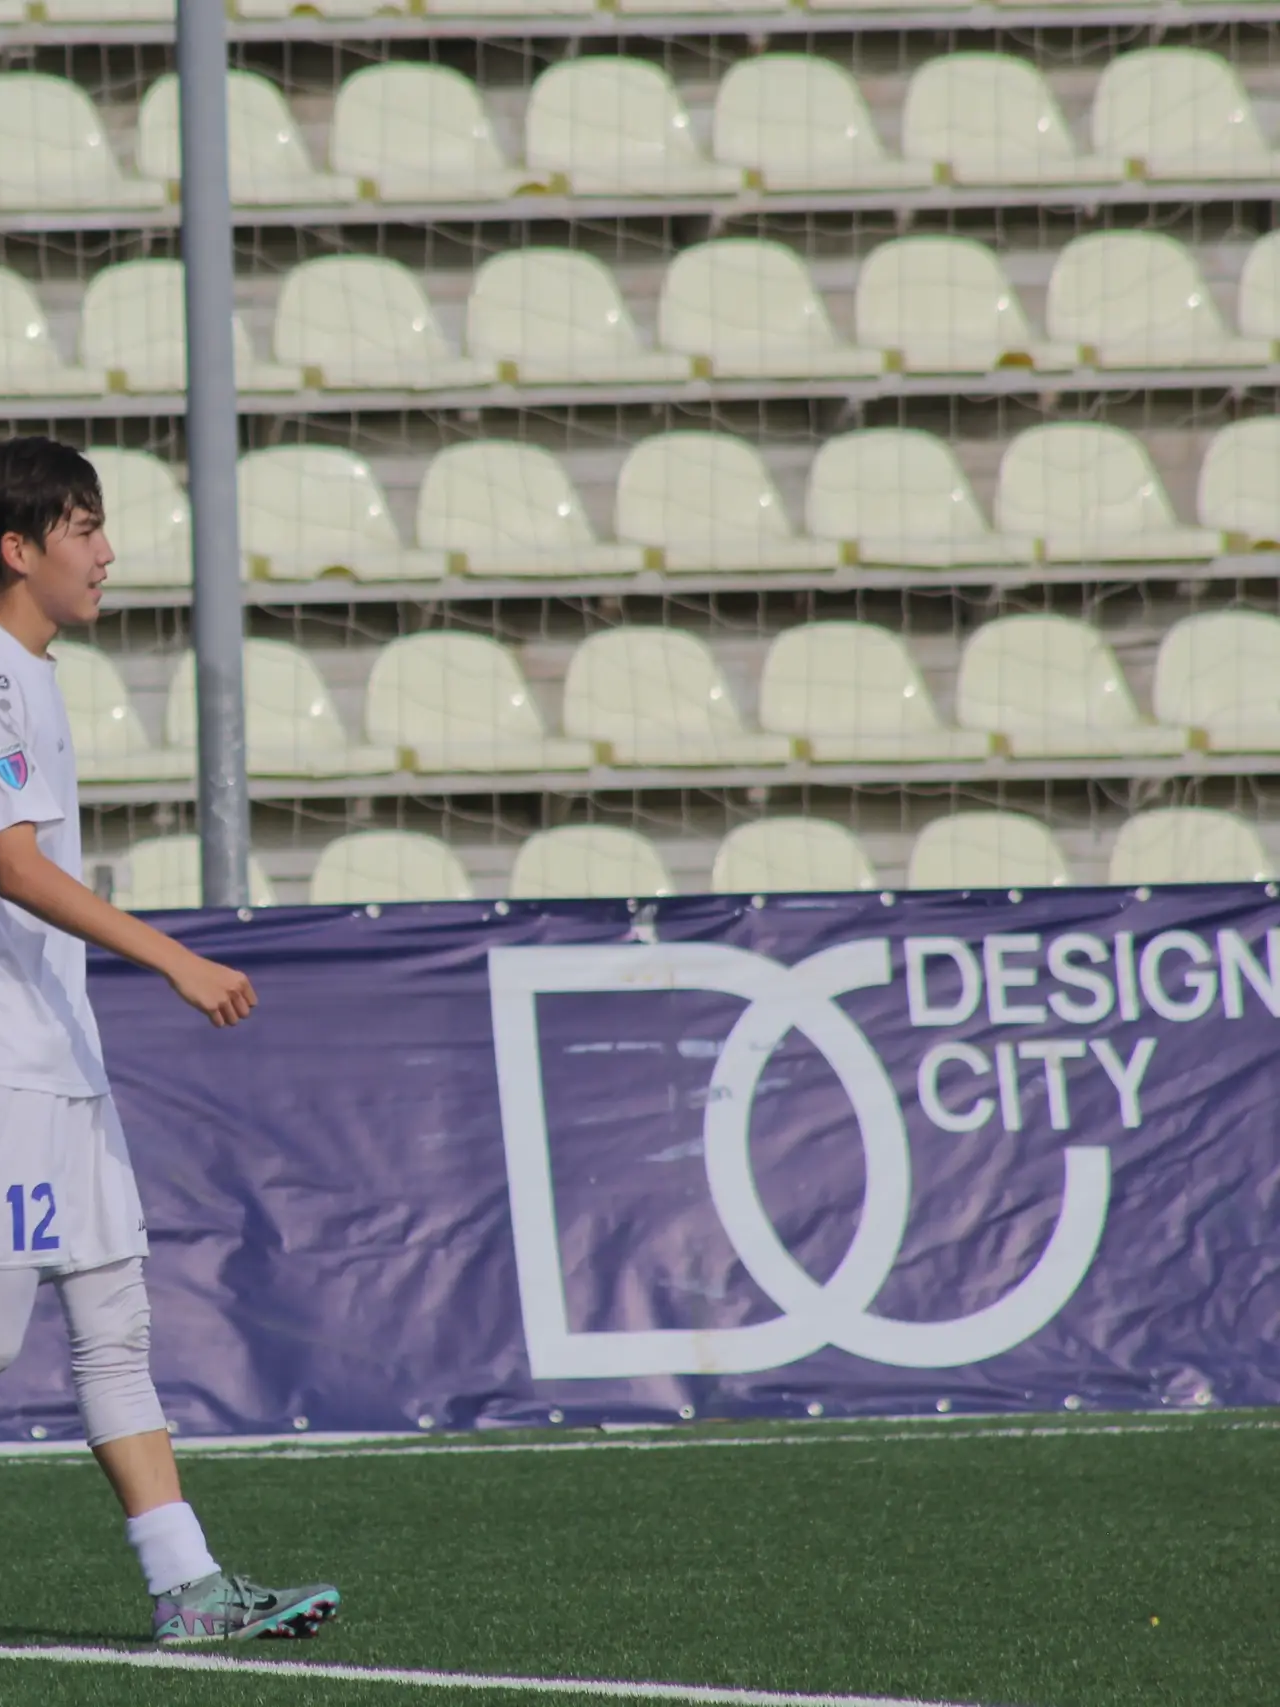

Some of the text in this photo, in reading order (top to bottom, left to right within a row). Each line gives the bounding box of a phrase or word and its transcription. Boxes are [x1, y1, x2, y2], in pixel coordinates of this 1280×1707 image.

[903, 928, 1280, 1027] DESIGN
[917, 1036, 1157, 1133] CITY
[6, 1182, 60, 1251] 12
